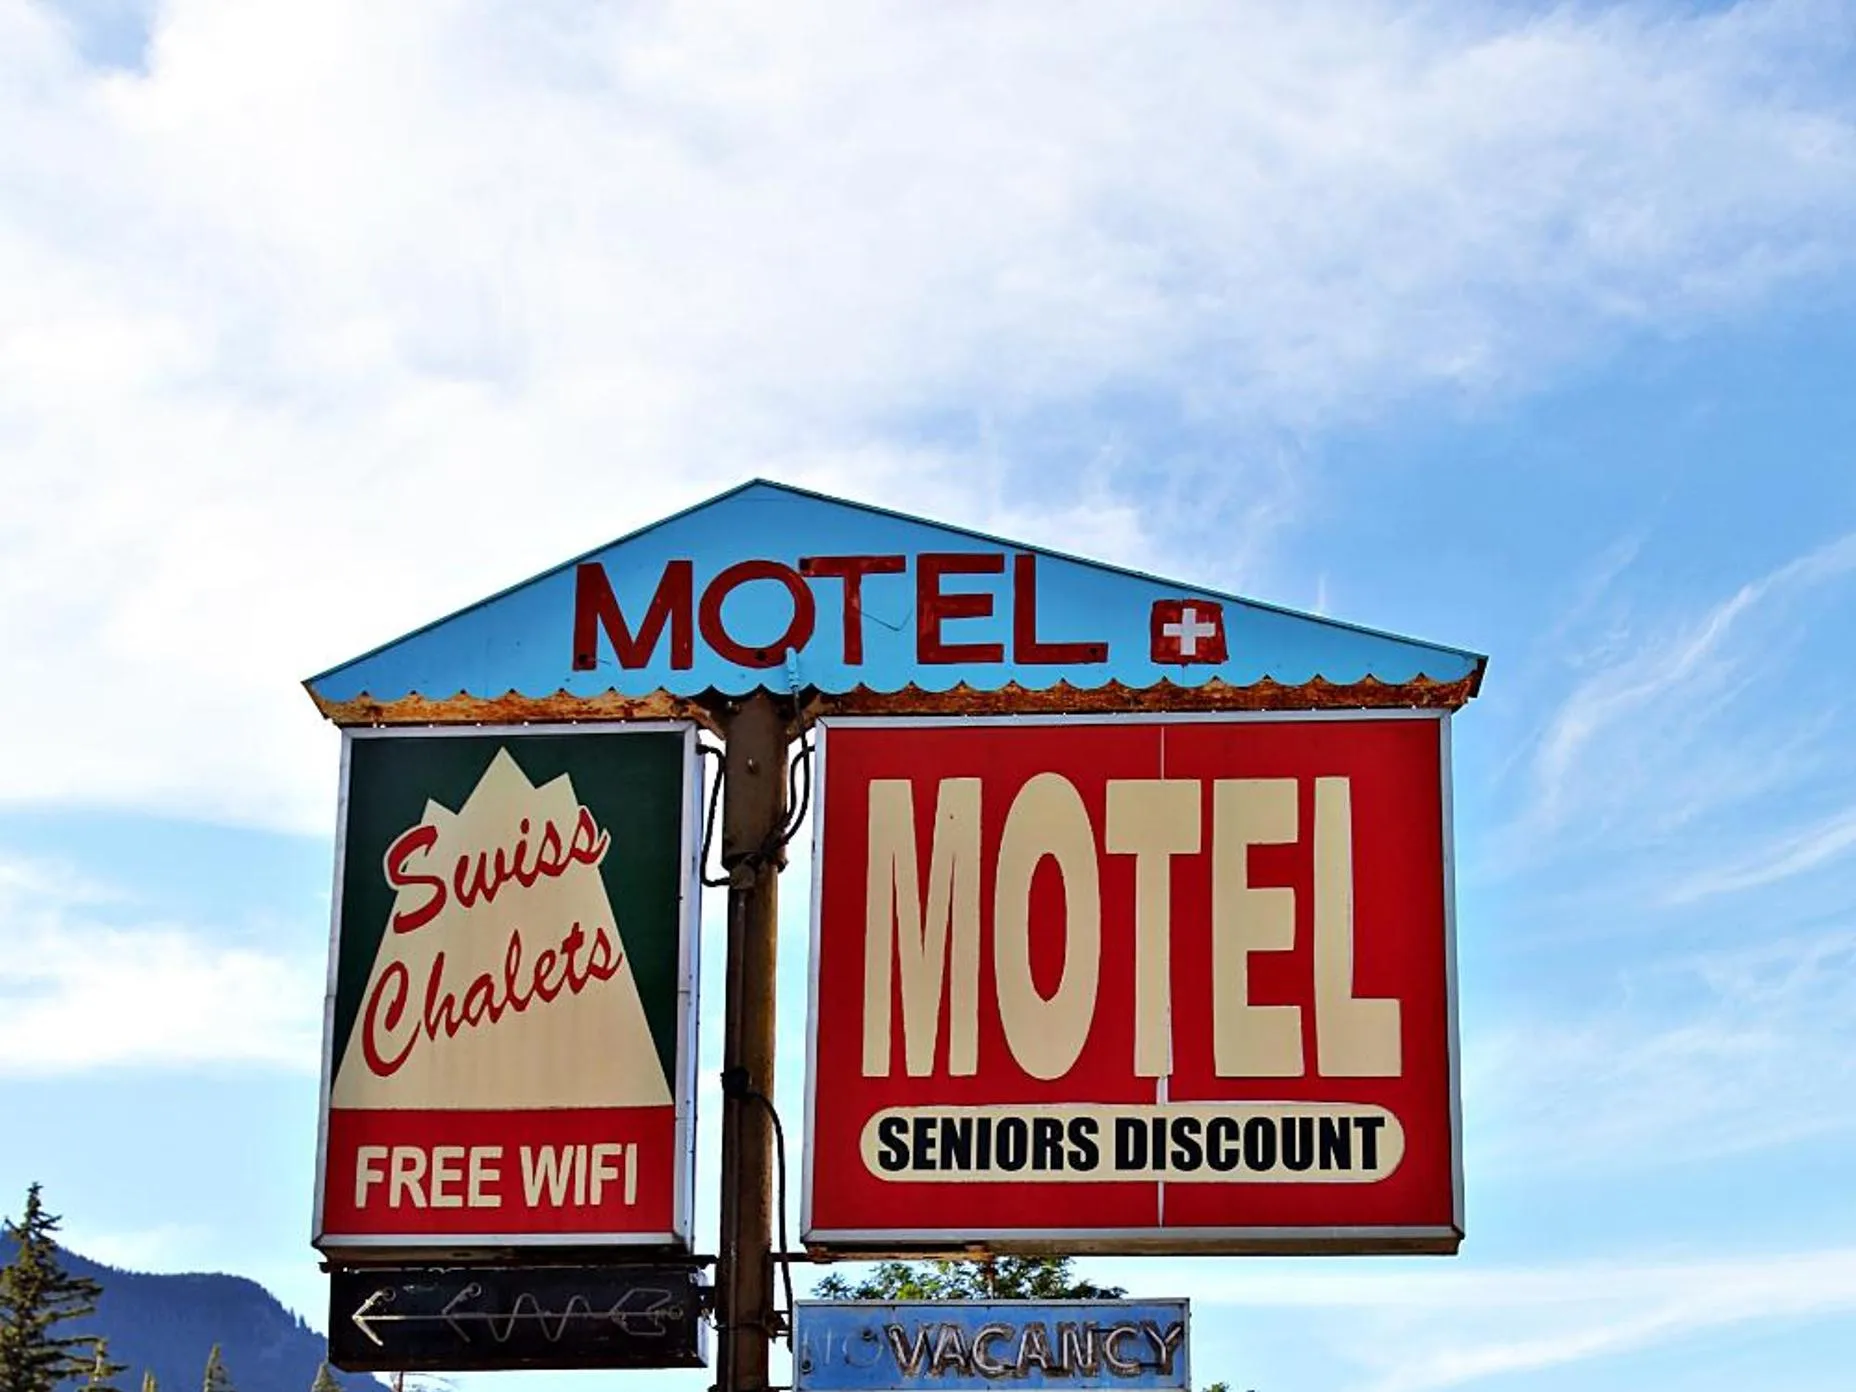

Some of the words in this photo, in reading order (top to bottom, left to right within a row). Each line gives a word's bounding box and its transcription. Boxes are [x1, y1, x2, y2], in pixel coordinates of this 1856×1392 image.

[573, 554, 1108, 670] MOTEL
[387, 806, 610, 934] Swiss
[862, 772, 1402, 1080] MOTEL
[361, 921, 623, 1077] Chalets
[355, 1144, 502, 1208] FREE
[520, 1143, 637, 1207] WIFI
[878, 1116, 1099, 1172] SENIORS
[1115, 1116, 1385, 1172] DISCOUNT
[885, 1322, 1182, 1377] VACANCY
